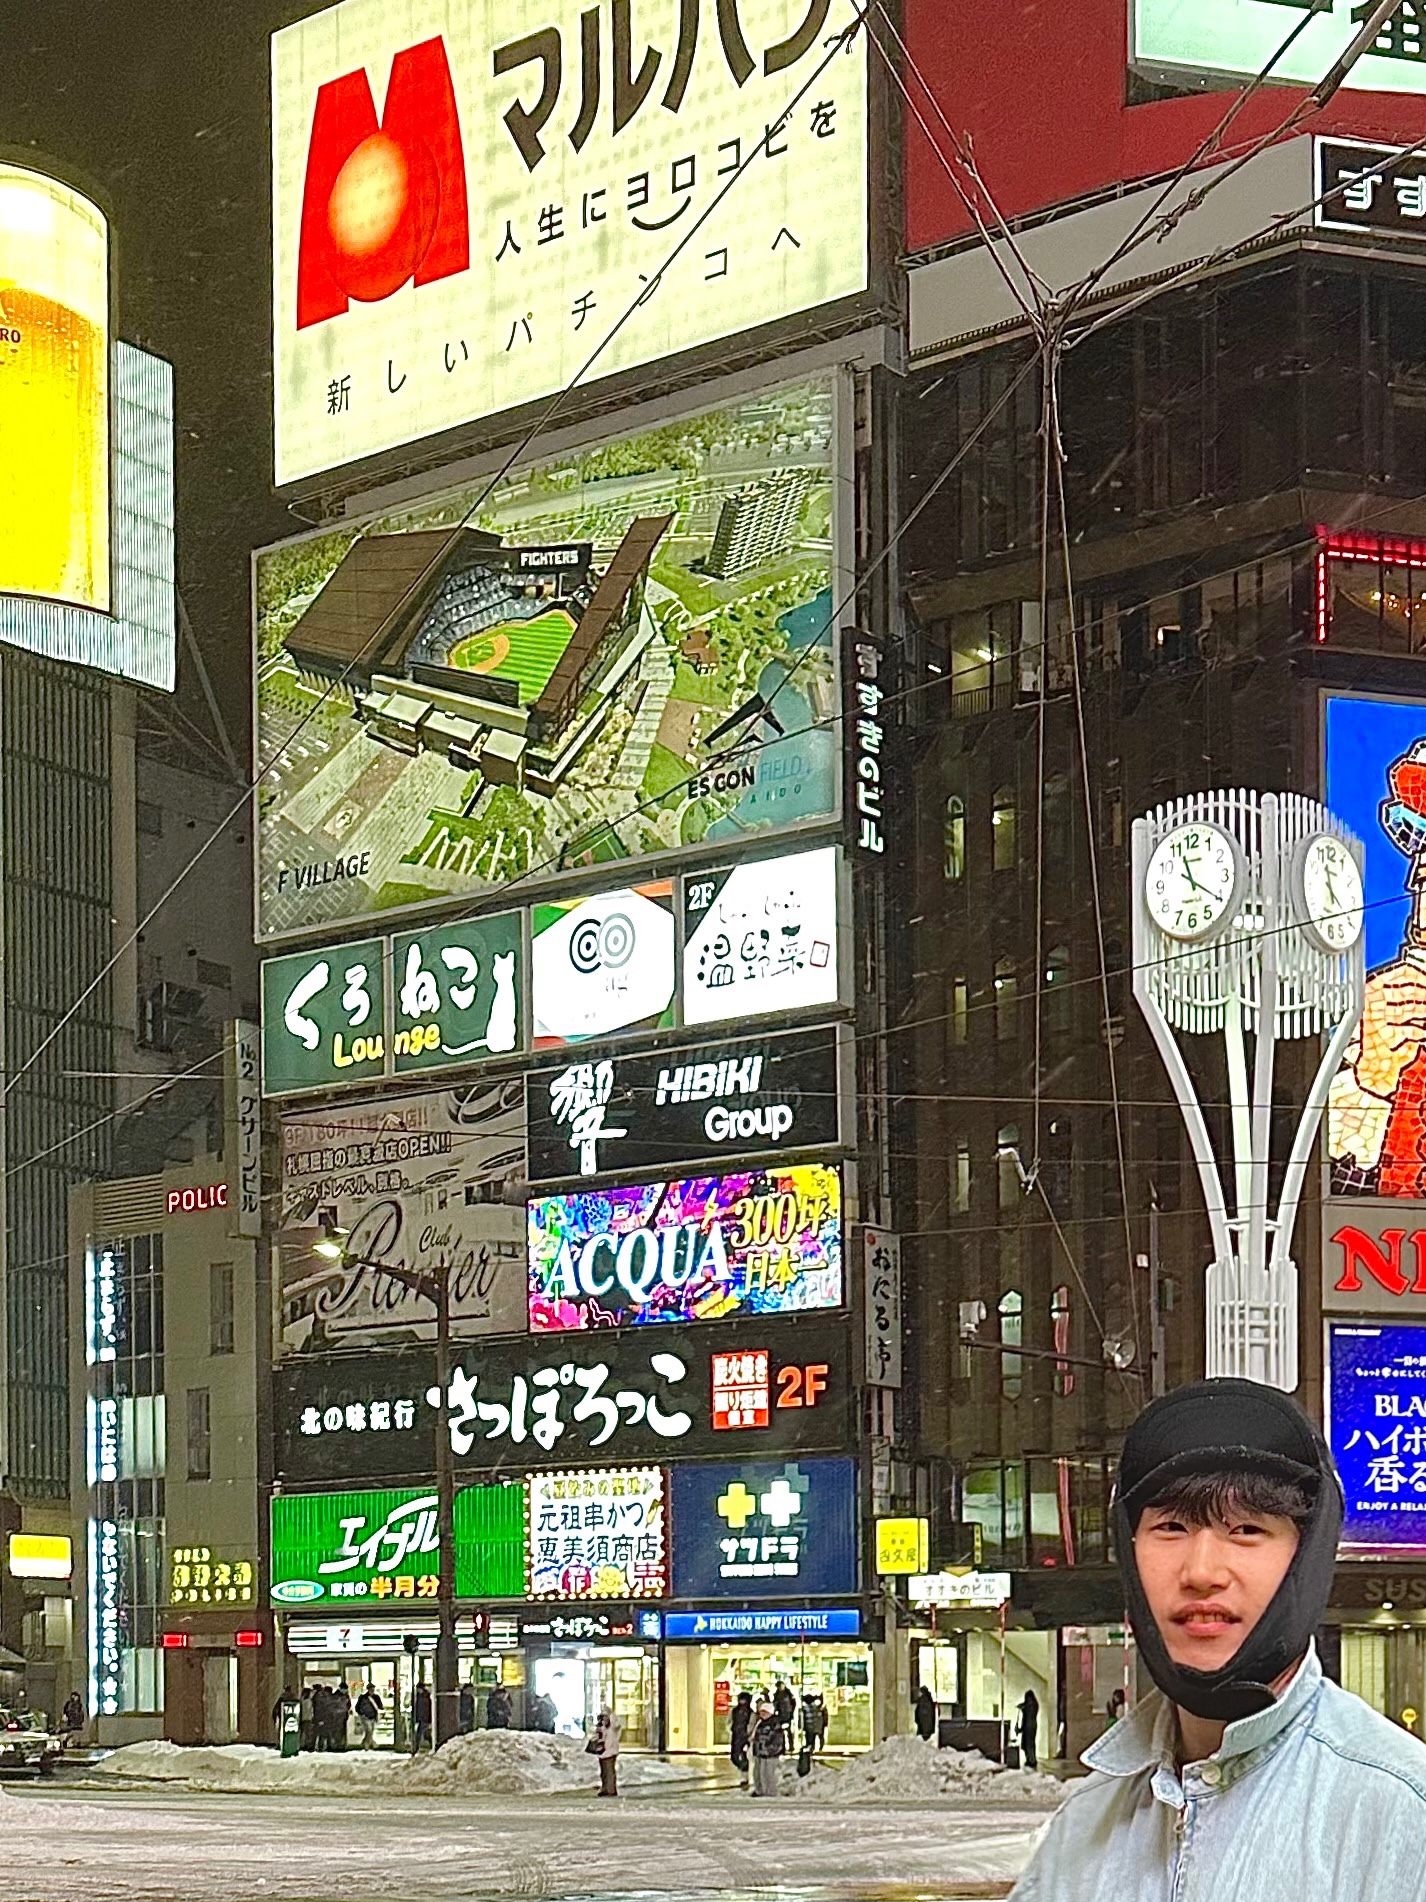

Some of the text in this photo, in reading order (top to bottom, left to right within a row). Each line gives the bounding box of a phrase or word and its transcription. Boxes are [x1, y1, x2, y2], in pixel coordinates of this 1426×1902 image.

[495, 100, 837, 262] 人生にヨロコビを
[326, 227, 801, 416] 新しいパチンコへ
[520, 549, 579, 567] FIGHTERS
[1170, 843, 1182, 858] 11
[1184, 833, 1200, 850] 12
[1205, 837, 1212, 852] 1
[1216, 849, 1225, 864] 2
[1326, 846, 1337, 863] 12
[278, 851, 371, 893] F VILLAGE
[1159, 861, 1174, 875] 10
[1221, 868, 1230, 883] 3
[688, 881, 715, 912] 2F
[1156, 880, 1165, 895] 9
[1161, 899, 1170, 914] 8
[1174, 910, 1184, 926] 7
[1187, 913, 1198, 929] 6
[1203, 905, 1213, 920] 5
[284, 942, 480, 1051] くろねこ
[333, 1022, 442, 1068] Lounge
[655, 1055, 763, 1106] HIBIKI
[704, 1105, 793, 1141] Group
[730, 1193, 829, 1249] 300坪
[419, 1223, 453, 1253] Club
[541, 1222, 734, 1304] ACQUA
[743, 1247, 829, 1296] 日本一
[776, 1364, 829, 1408] 2F
[300, 1399, 416, 1435] 北の味紀行
[425, 1352, 692, 1457] さっぽろっこ
[538, 1502, 644, 1532] 元祖串かつ
[1356, 1501, 1390, 1511] ENJOY
[1391, 1502, 1399, 1511] A
[537, 1533, 658, 1564] 恵美須商店
[370, 1574, 441, 1599] 半月分
[708, 1614, 829, 1632] HOKKAIDO HAPPY LIFESTYLE
